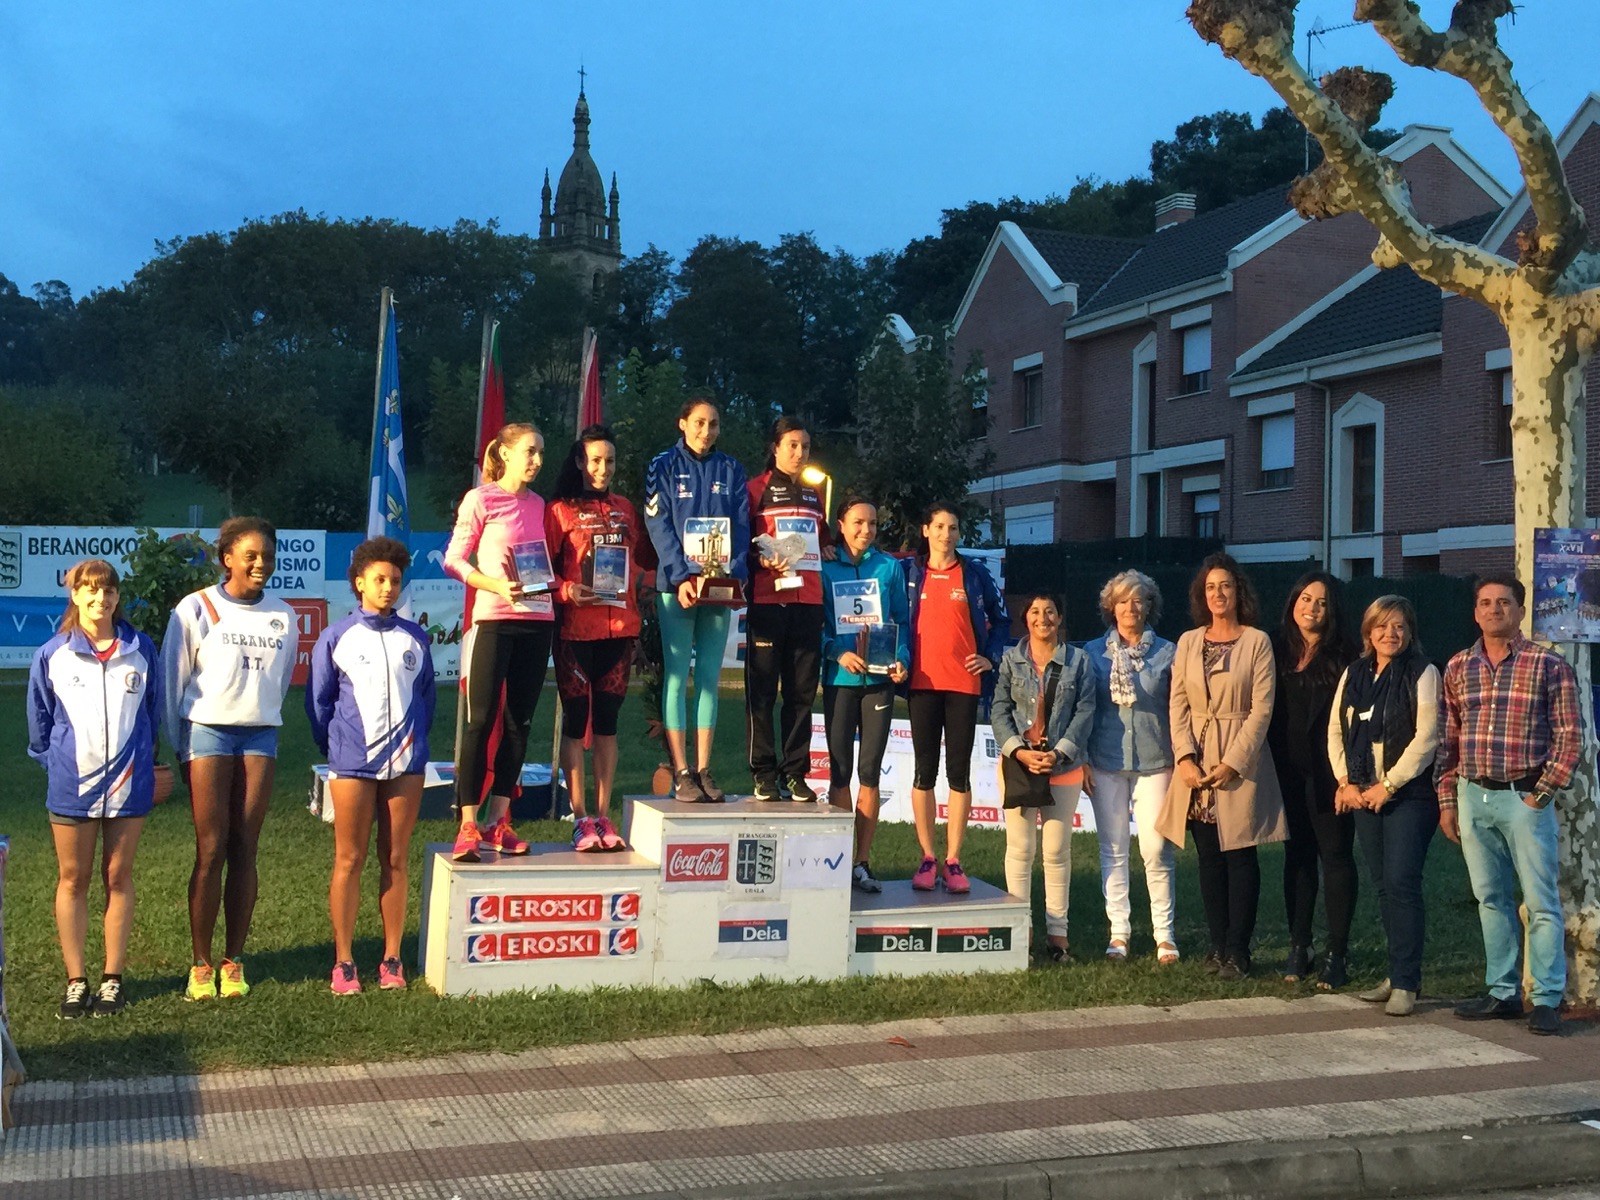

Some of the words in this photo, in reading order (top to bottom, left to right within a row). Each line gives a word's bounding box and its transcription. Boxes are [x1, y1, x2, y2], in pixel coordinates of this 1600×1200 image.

[28, 537, 138, 556] BERANGOKO
[277, 539, 315, 553] NGO
[277, 558, 321, 572] ISMO
[853, 598, 864, 615] 5
[222, 632, 283, 650] BERANGO
[242, 656, 265, 671] A.T.
[510, 899, 595, 917] EROSKI
[743, 926, 781, 941] Deia
[507, 935, 594, 955] EROSKI
[882, 935, 925, 951] Deia
[963, 935, 1004, 951] Deia
